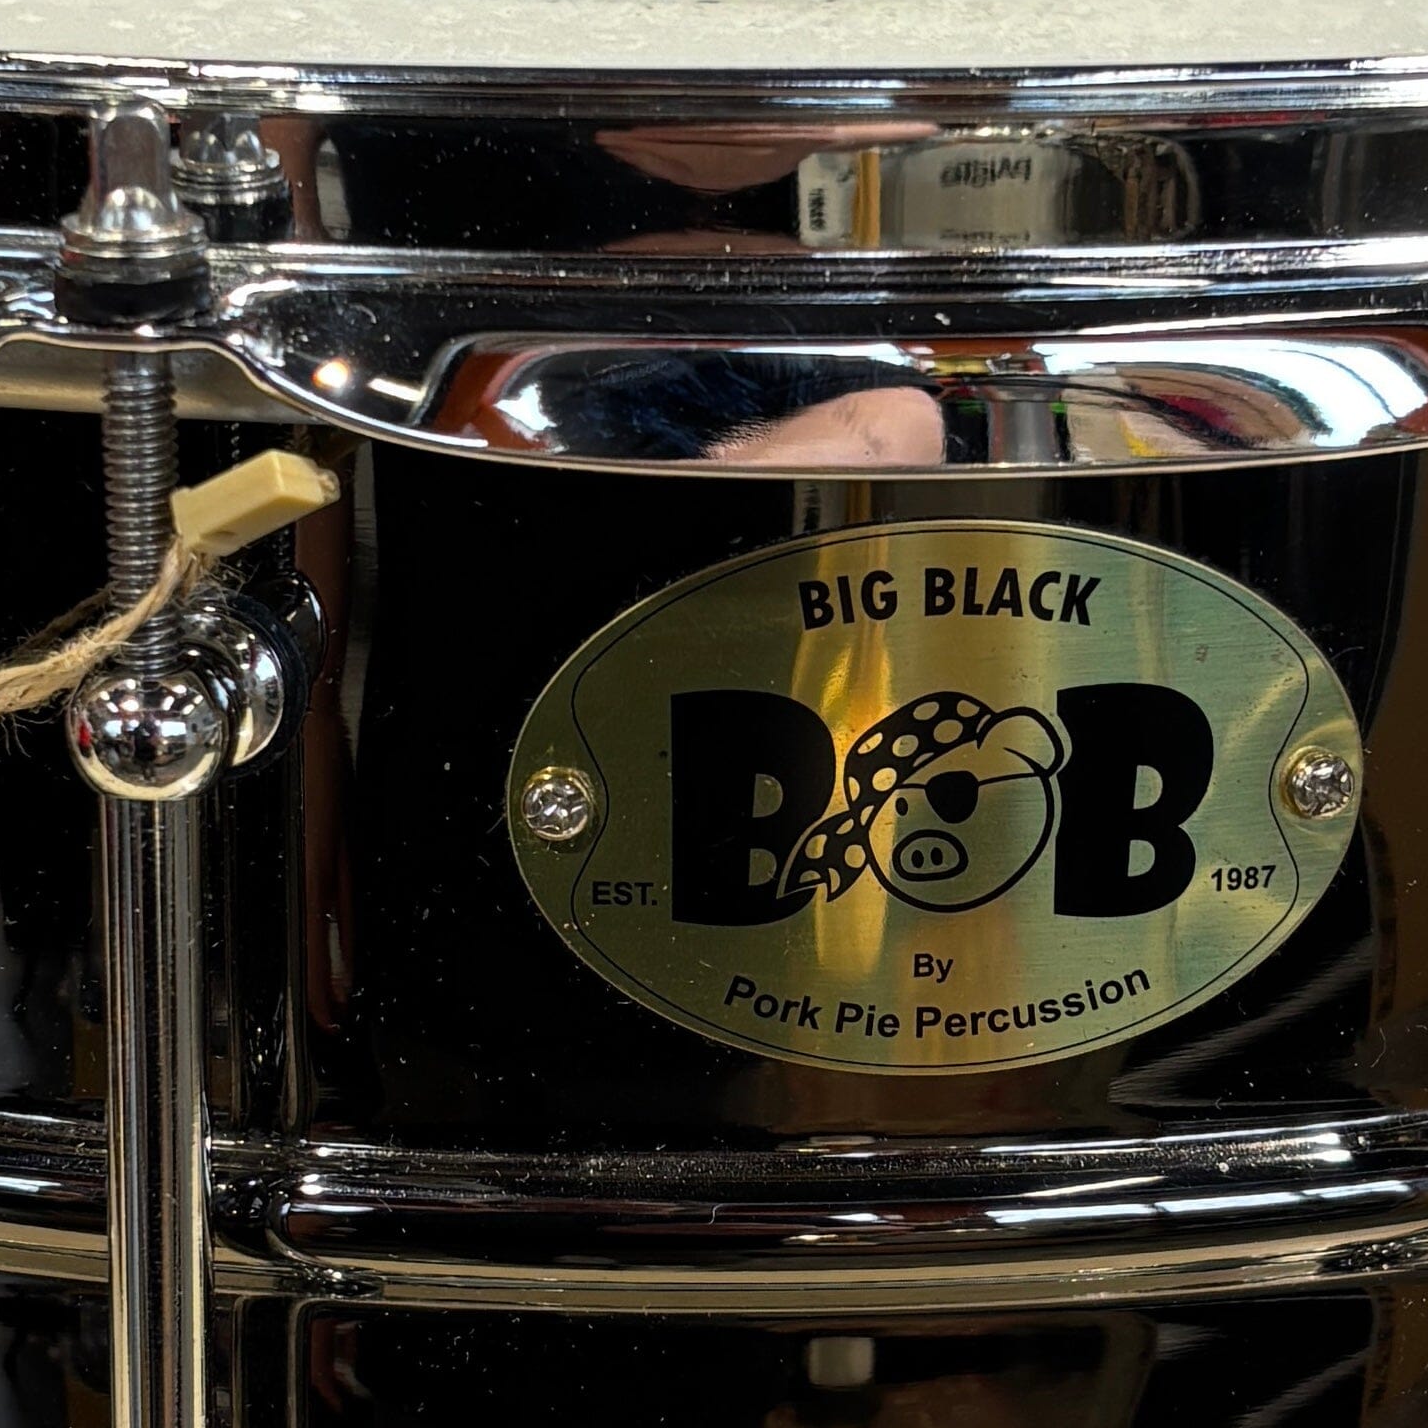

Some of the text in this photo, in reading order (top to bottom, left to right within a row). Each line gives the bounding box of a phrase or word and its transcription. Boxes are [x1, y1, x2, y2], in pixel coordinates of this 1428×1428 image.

[798, 565, 1103, 631] BIG BLACK
[591, 880, 659, 908] EST.
[1210, 864, 1278, 894] 1987
[912, 952, 955, 985] By
[723, 965, 1152, 1039] Pork Pie Percussion
